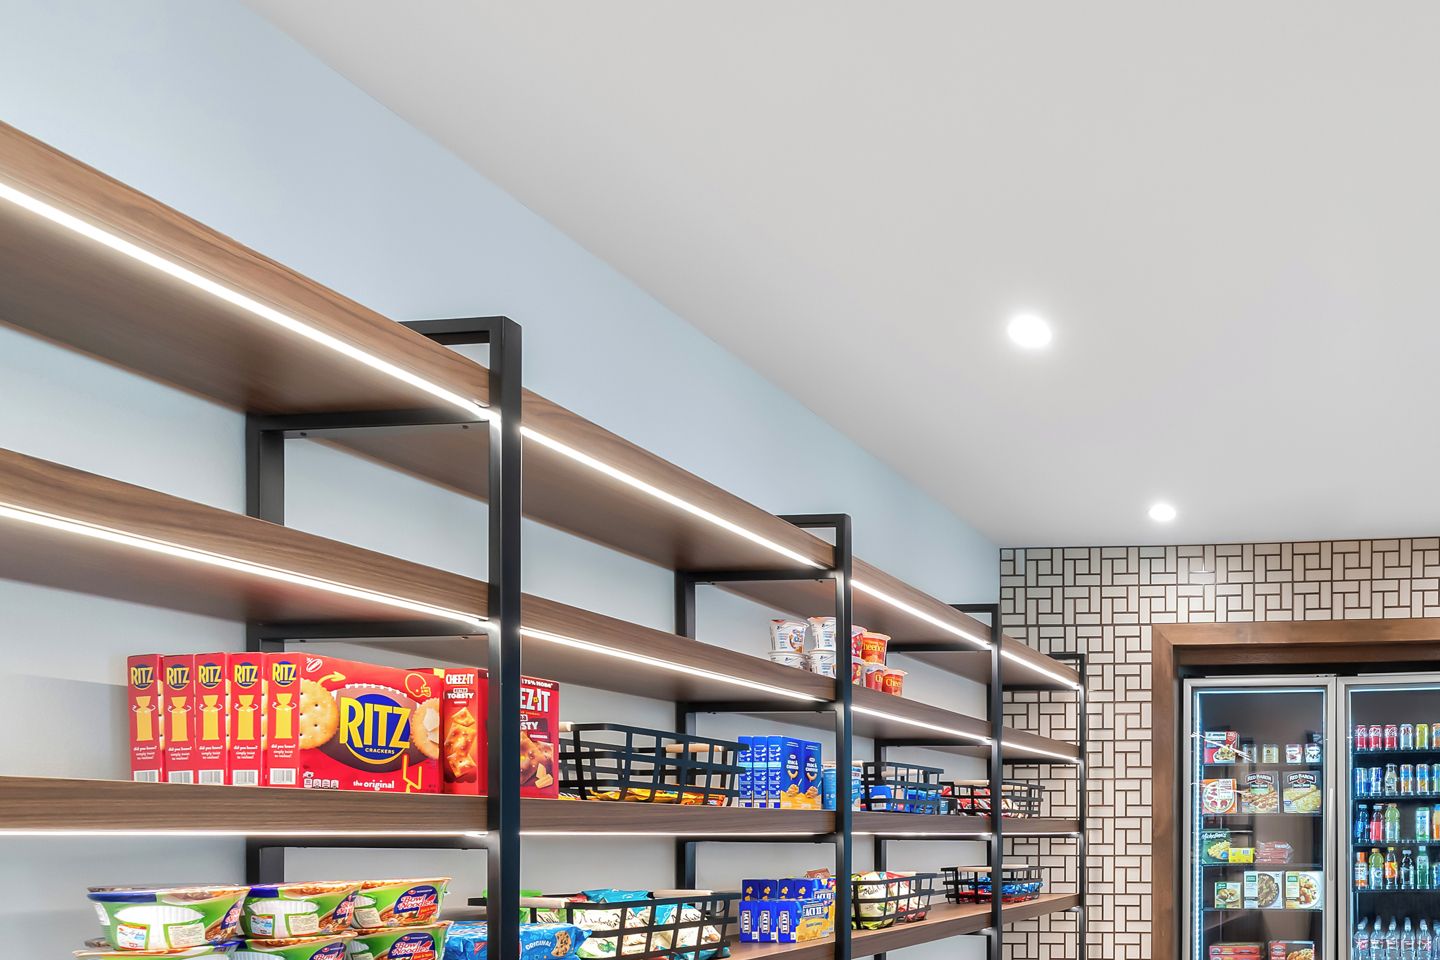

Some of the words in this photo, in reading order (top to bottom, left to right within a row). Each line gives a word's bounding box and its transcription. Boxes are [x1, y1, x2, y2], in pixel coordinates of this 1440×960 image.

[863, 643, 885, 653] heerios
[130, 666, 154, 685] RITZ
[166, 667, 191, 685] RITZ
[198, 665, 222, 685] RITZ
[234, 665, 258, 683] RITZ
[272, 663, 297, 682] RITZ
[520, 688, 551, 713] EZ-IT
[339, 696, 412, 749] RITZ
[520, 721, 539, 731] STY
[365, 747, 395, 755] CRACKERS
[1256, 774, 1272, 782] BARON
[1298, 773, 1314, 781] BARON
[363, 780, 395, 791] original
[400, 895, 426, 904] Bowl
[397, 900, 435, 910] Noodles
[395, 940, 421, 949] Bowl
[526, 941, 551, 950] ORIGINAL
[392, 945, 431, 956] Noodles
